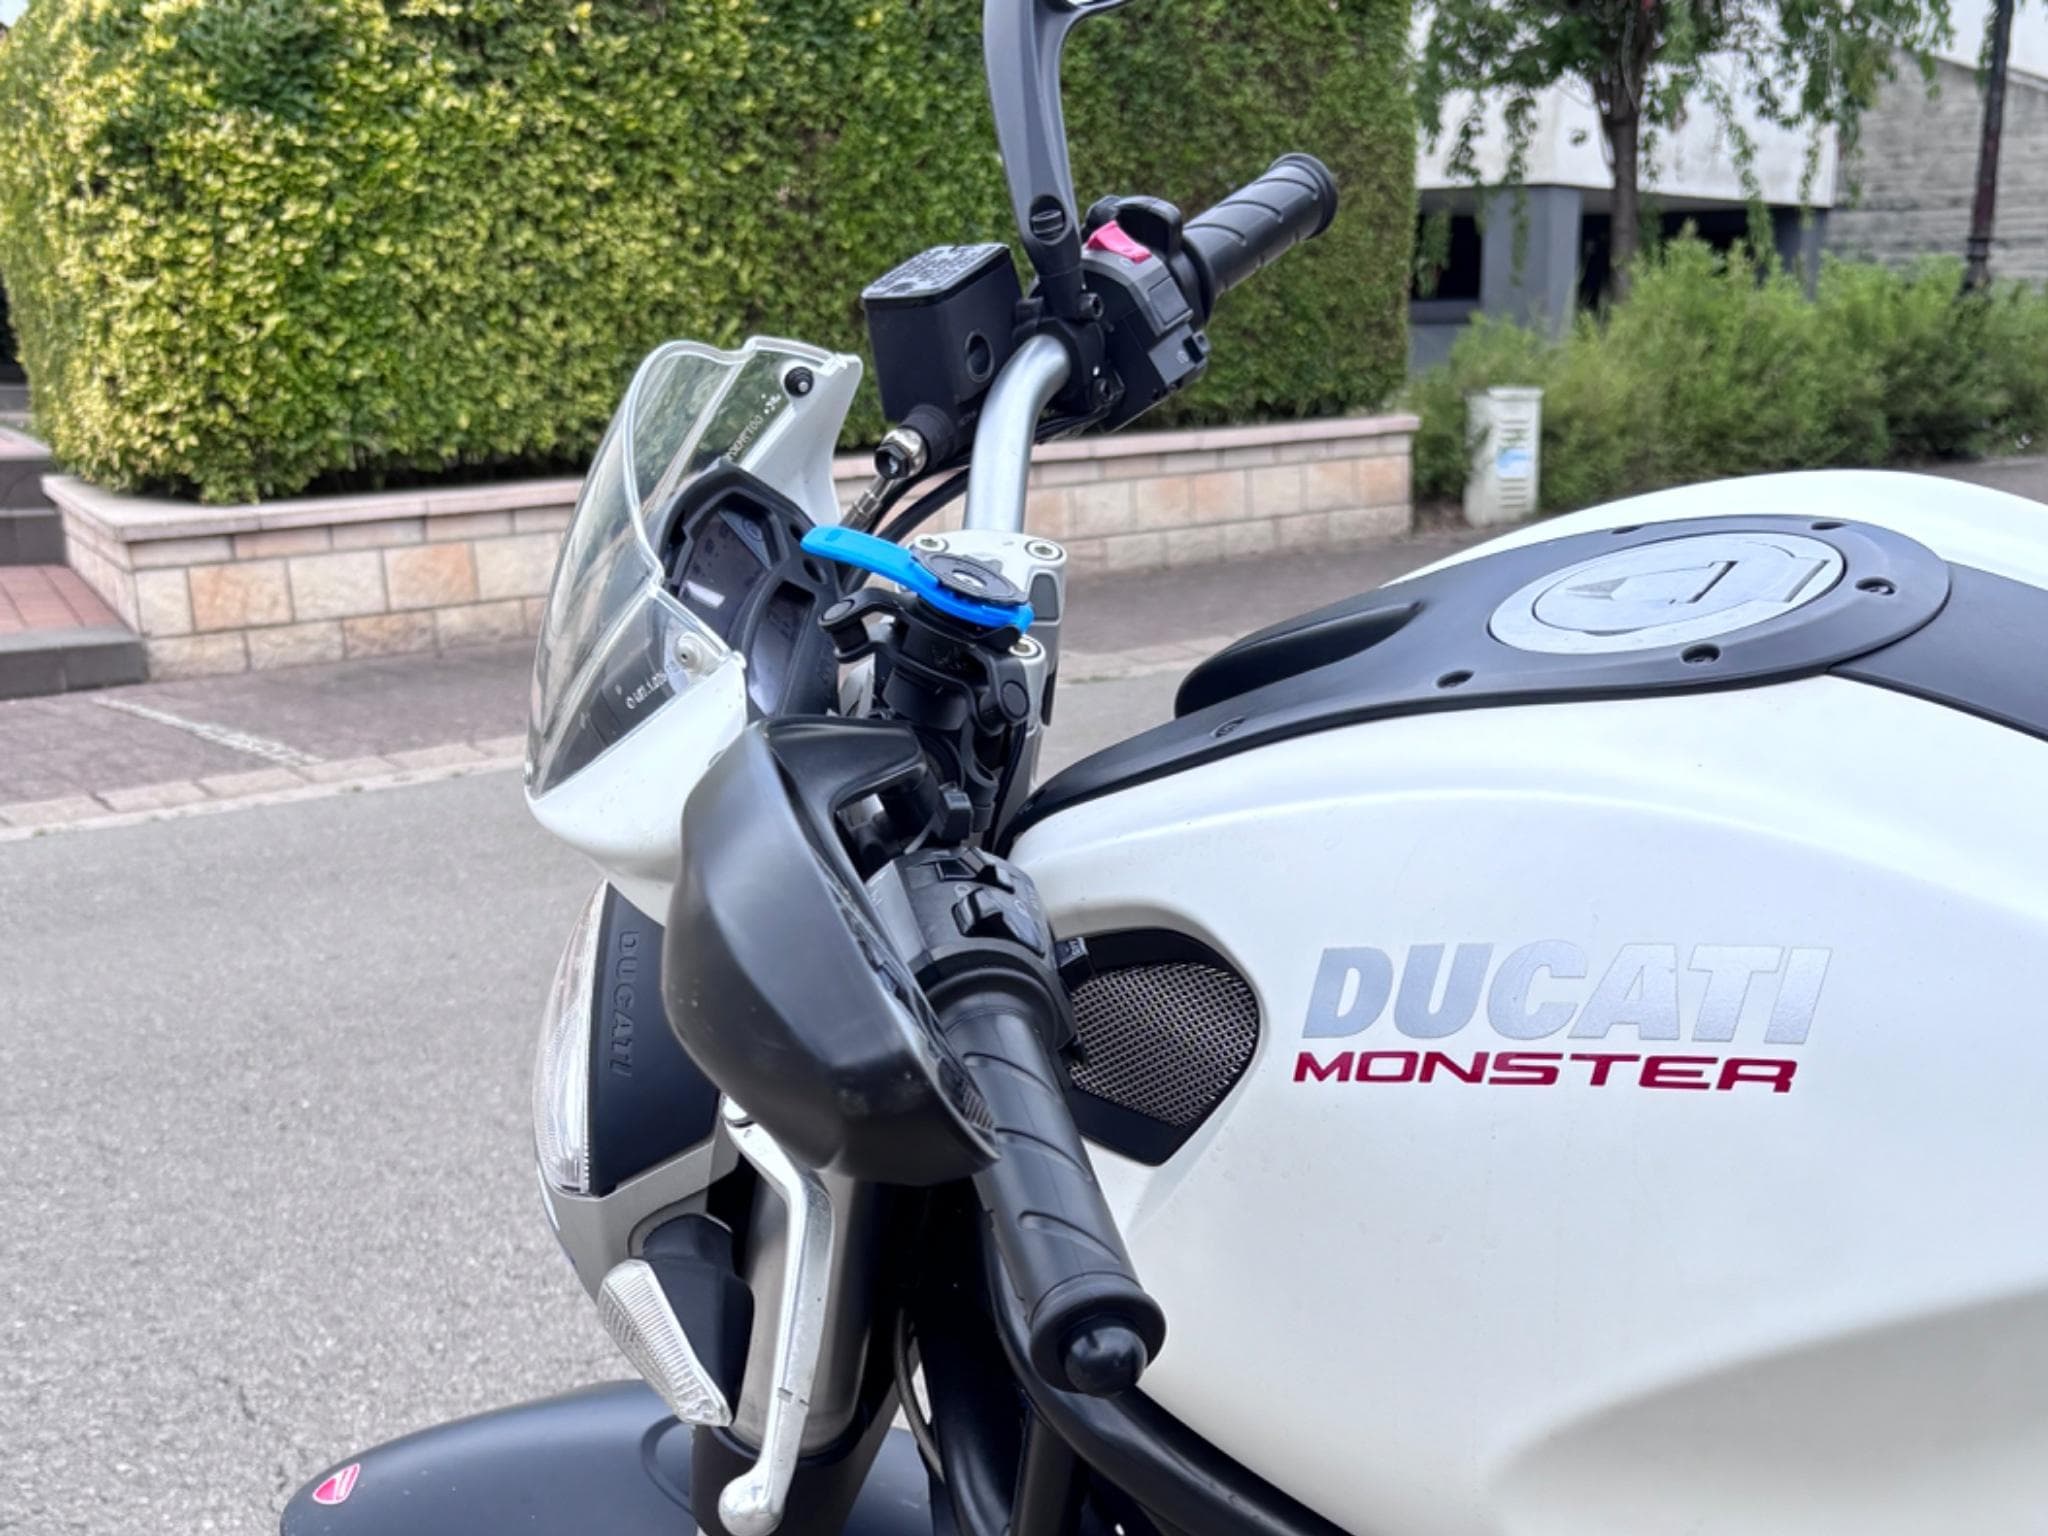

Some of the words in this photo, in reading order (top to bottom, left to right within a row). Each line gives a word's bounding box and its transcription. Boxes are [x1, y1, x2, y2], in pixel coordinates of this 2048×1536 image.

[609, 930, 640, 1079] DUCATI
[1301, 939, 1832, 1045] DUCATI
[1292, 1051, 1798, 1093] MONSTER
